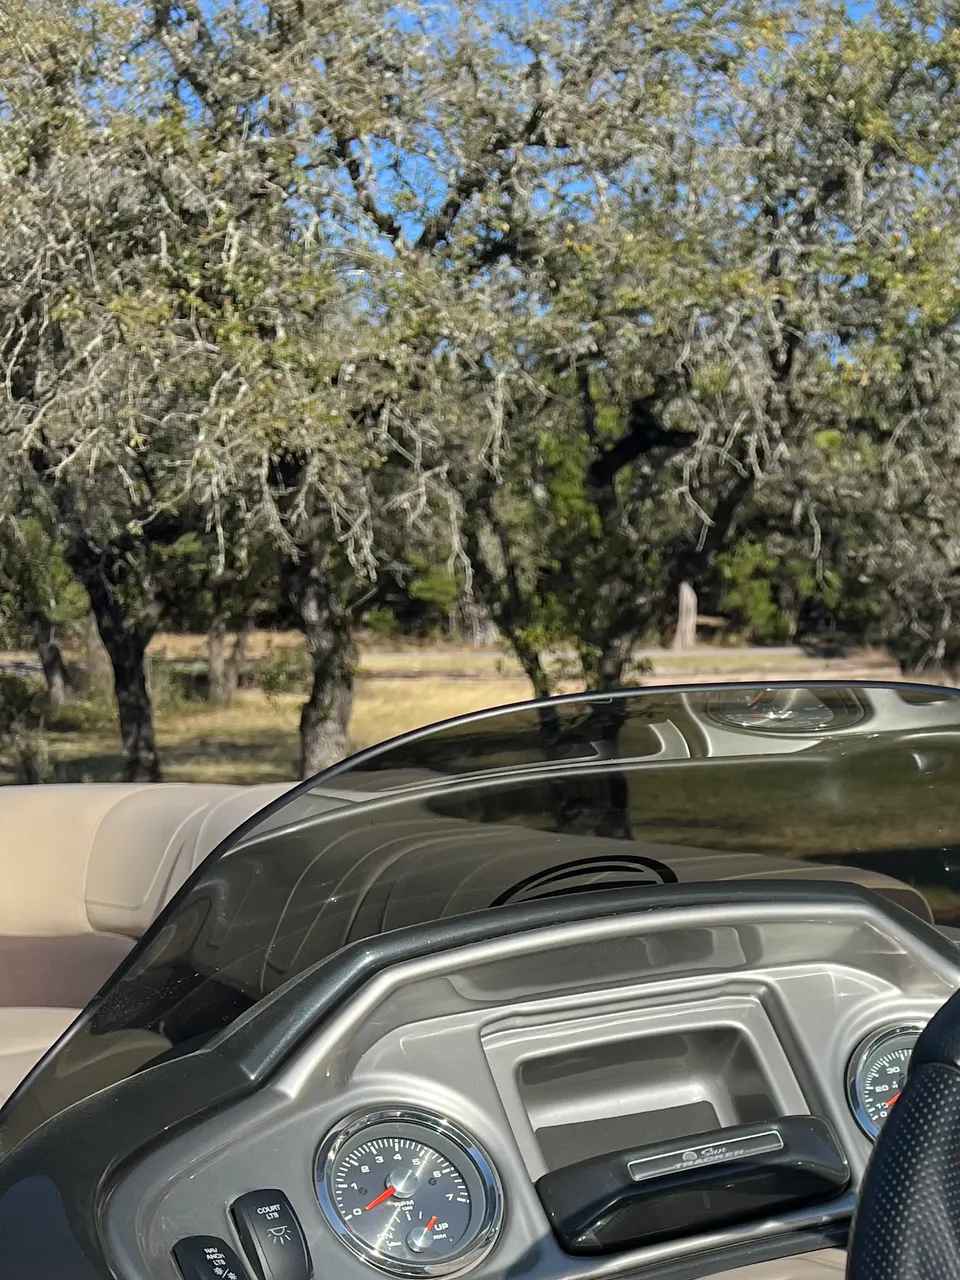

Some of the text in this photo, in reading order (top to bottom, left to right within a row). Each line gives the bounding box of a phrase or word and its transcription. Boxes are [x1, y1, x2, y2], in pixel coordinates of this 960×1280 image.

[701, 1147, 727, 1156] Sun
[361, 1165, 370, 1173] 2
[445, 1193, 454, 1201] 7
[257, 1204, 280, 1214] COURT
[434, 1223, 449, 1231] UP
